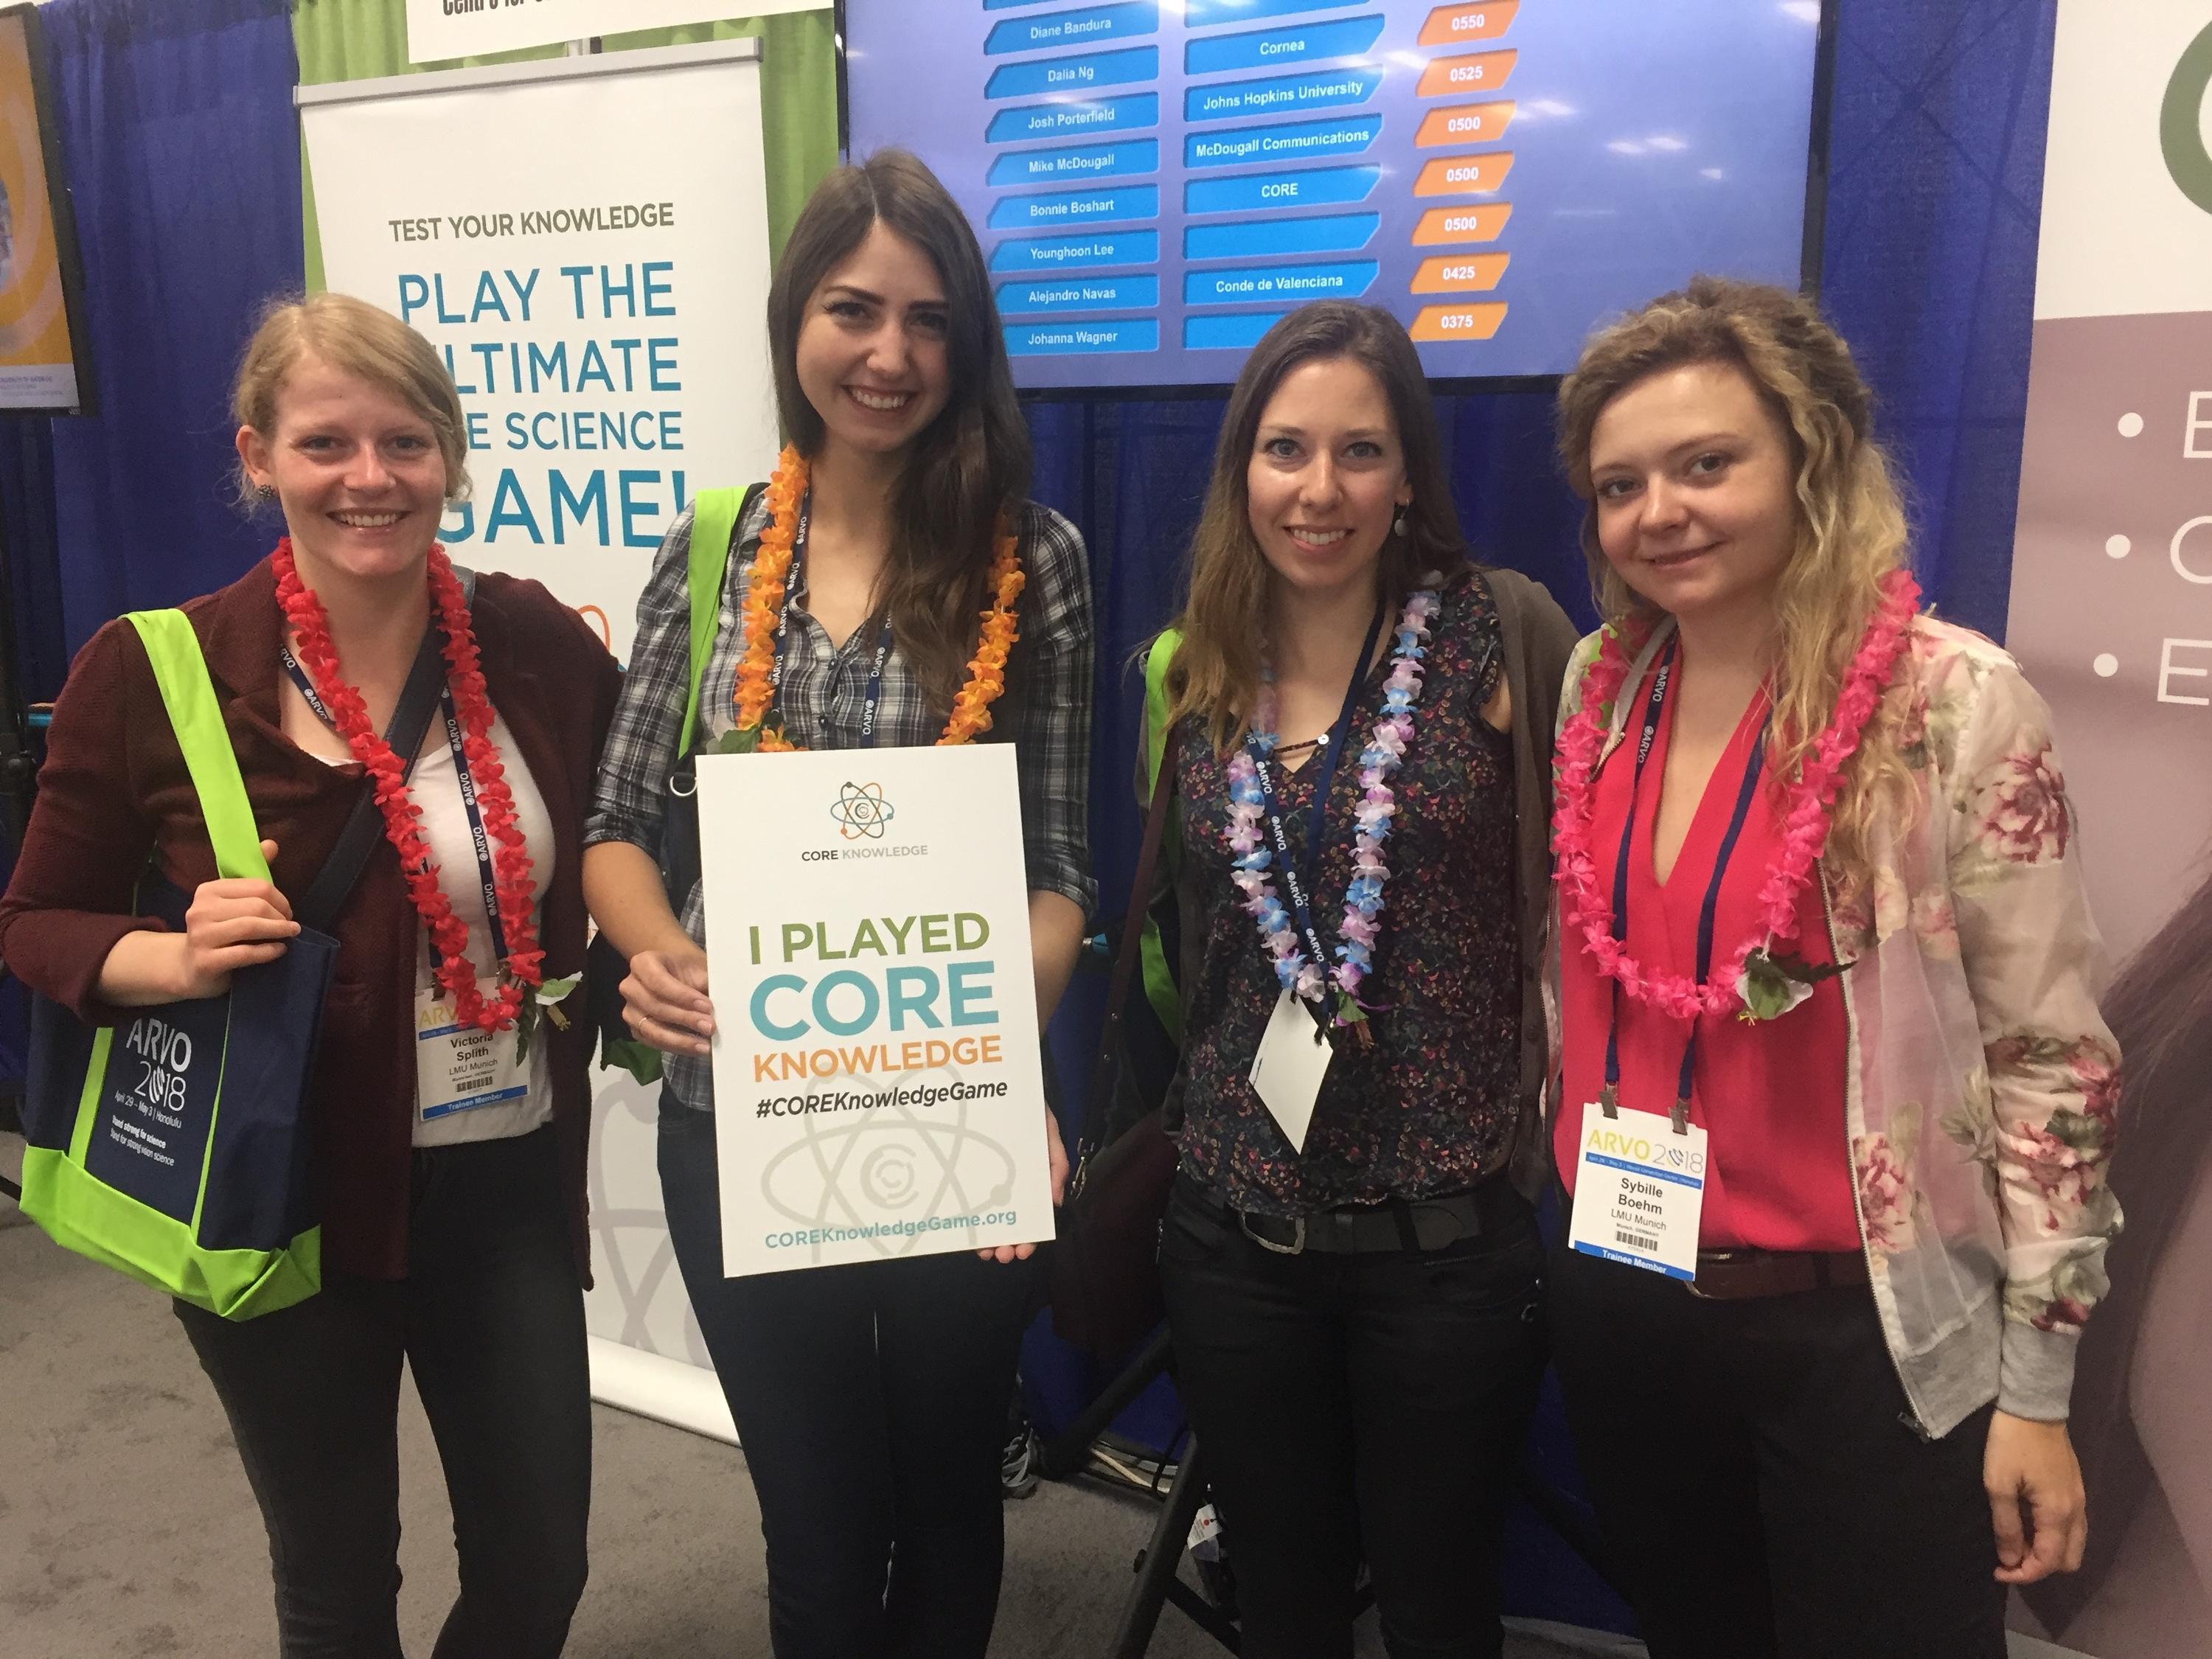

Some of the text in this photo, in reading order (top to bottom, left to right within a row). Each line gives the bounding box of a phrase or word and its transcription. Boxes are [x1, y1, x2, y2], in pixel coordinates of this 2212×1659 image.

[1030, 18, 1112, 39] Diane Bandura
[1451, 15, 1485, 31] 0550
[1259, 40, 1305, 55] Cornea
[1048, 66, 1094, 83] Dalia Ng
[1450, 66, 1484, 82] 0525
[1203, 80, 1363, 110] Johns Hopkins University
[1028, 109, 1115, 130] Josh Porterfield
[1448, 116, 1481, 132] 0500
[1196, 129, 1369, 158] McDougall Communications
[1029, 154, 1115, 173] Mike McDougall
[1446, 167, 1478, 183] 0500
[1261, 183, 1298, 198] CORE
[1030, 199, 1114, 217] Bonnie Boshart
[389, 203, 675, 242] TEST YOUR KNOWLEDGE
[1444, 216, 1477, 232] 0500
[1031, 243, 1114, 261] Younghoon Lee
[1442, 265, 1475, 281] 0425
[398, 262, 677, 324] PLAY THE
[1216, 274, 1343, 293] Conde de Valenciana
[1029, 287, 1116, 305] Alejandro Navas
[1441, 314, 1474, 330] 0375
[1028, 330, 1118, 345] Johanna Wagner
[433, 338, 682, 394] LTIMATE
[505, 411, 684, 451] SCIENCE
[801, 845, 928, 862] CORE KNOWLEDGE
[749, 912, 990, 964] I PLAYED
[750, 961, 999, 1041] CORE
[419, 1004, 457, 1027] ARV
[126, 1018, 192, 1072] ARVO
[451, 1034, 493, 1048] Victoria
[457, 1047, 489, 1062] Splith
[754, 1035, 1003, 1082] KNOWLEDGE
[449, 1065, 467, 1076] LMU
[470, 1059, 498, 1071] Munich
[757, 1081, 1008, 1118] #COREKnowledgeGame
[156, 1110, 181, 1128] Honolulu
[1587, 1129, 1650, 1161] ARVO
[153, 1152, 175, 1166] science
[1621, 1178, 1663, 1198] Sybille
[1618, 1194, 1662, 1214] Boehm
[765, 1211, 1016, 1248] COREKnowledgeGame.org
[1611, 1209, 1666, 1231] LMU Munich
[1602, 1249, 1632, 1265] Trainee
[1634, 1258, 1666, 1274] Member
